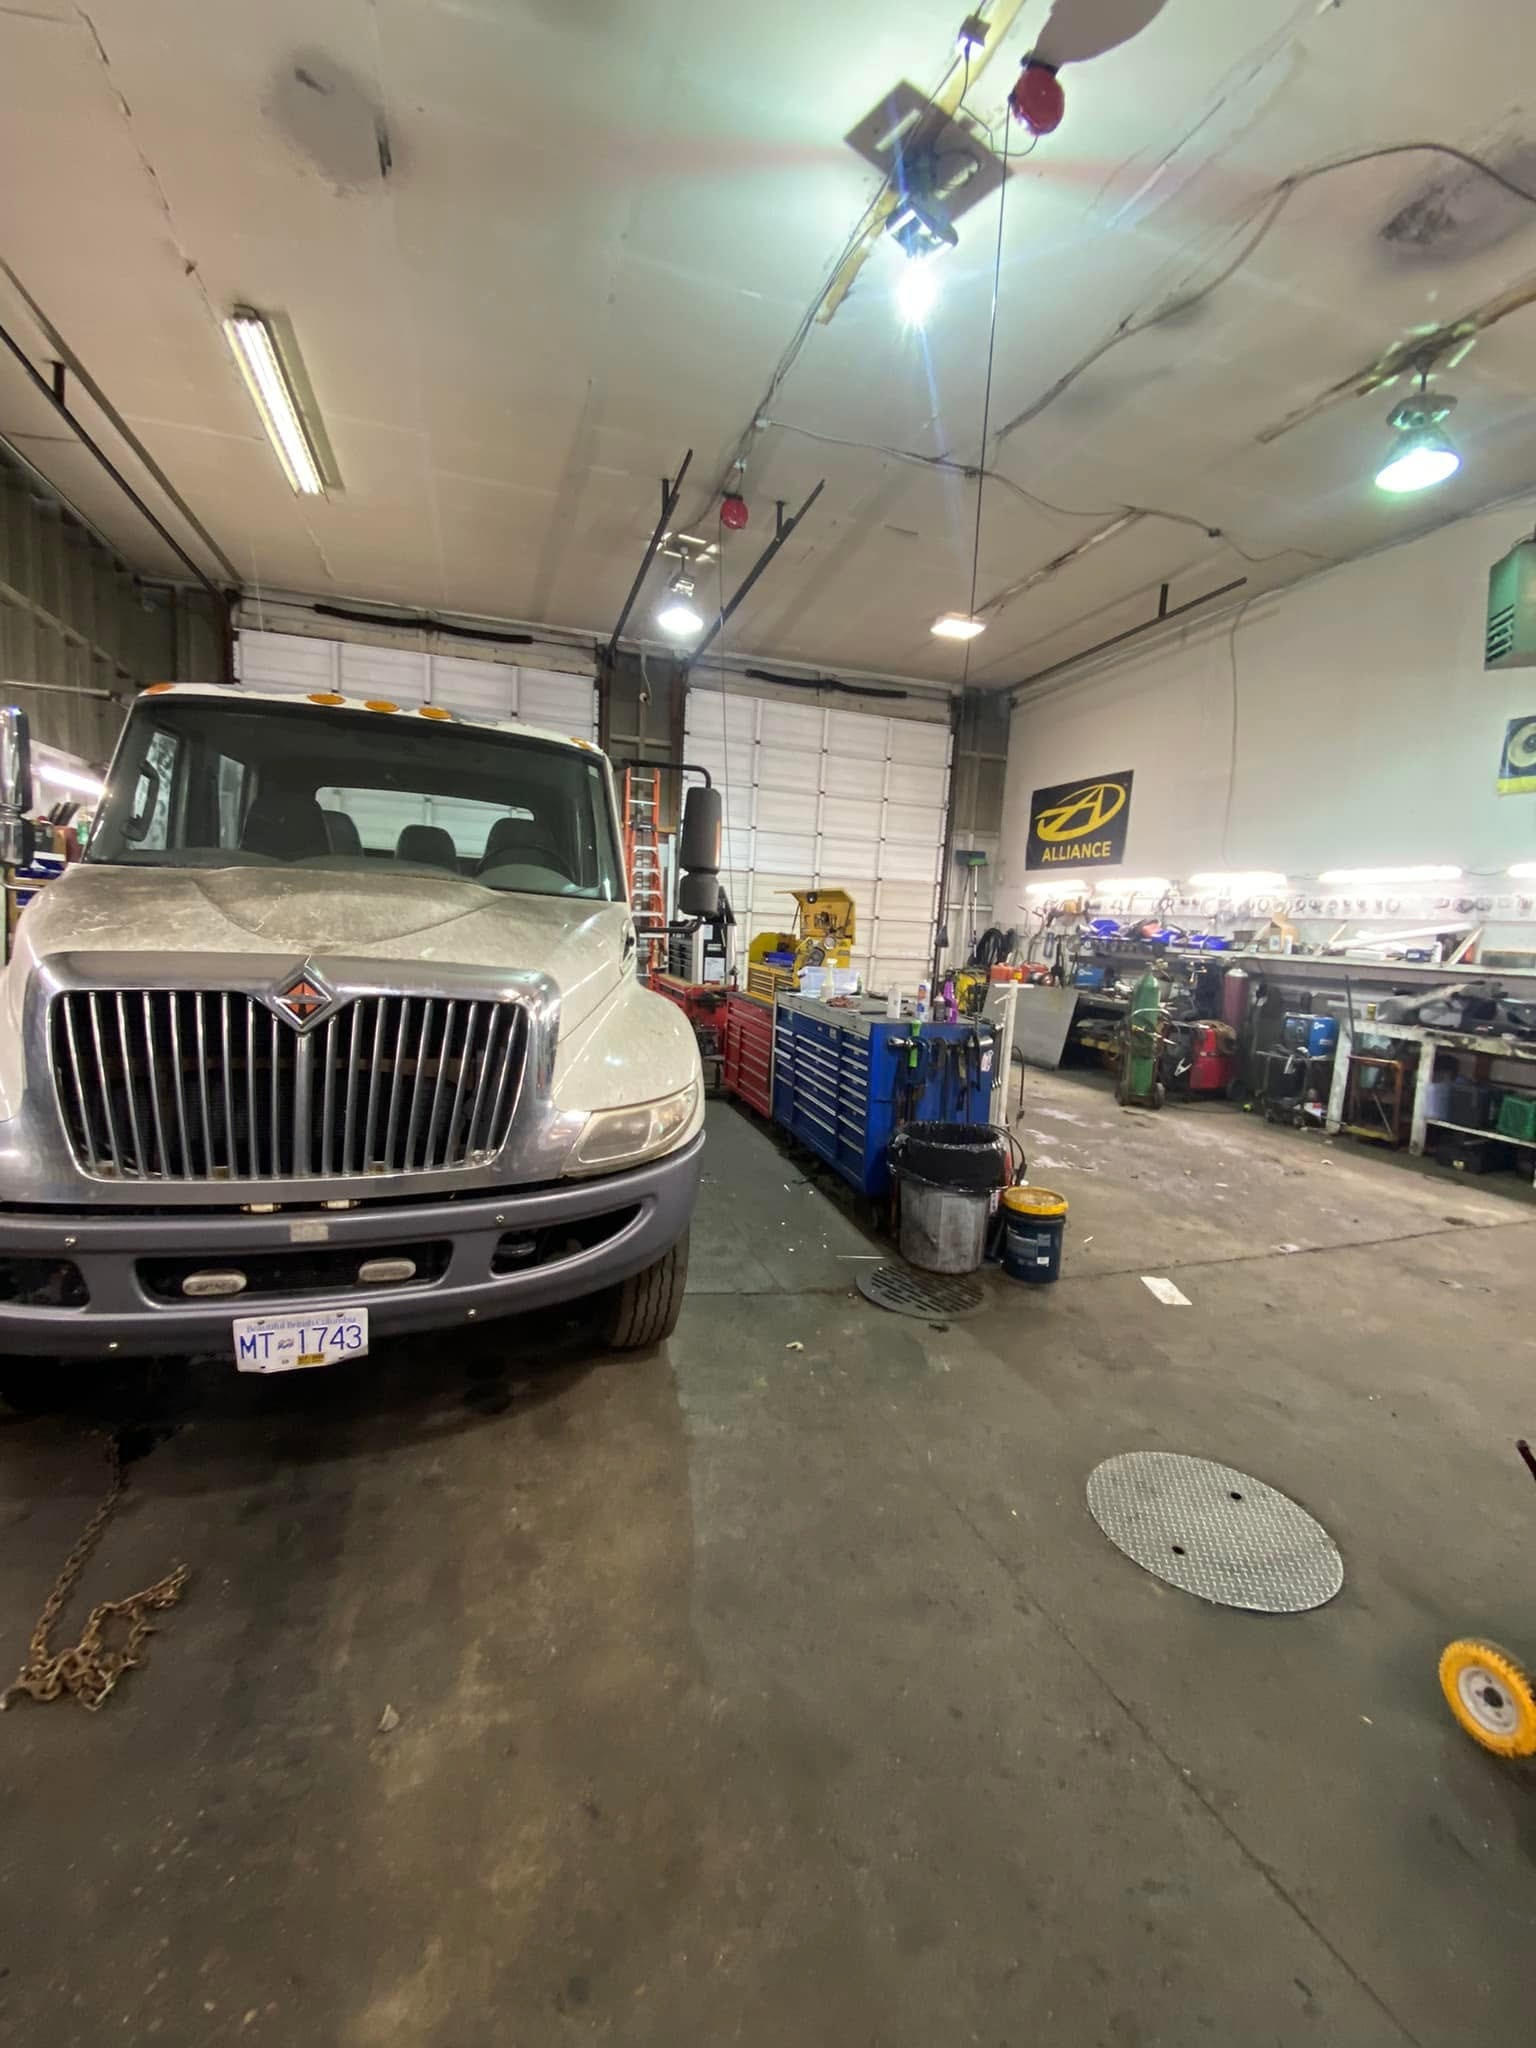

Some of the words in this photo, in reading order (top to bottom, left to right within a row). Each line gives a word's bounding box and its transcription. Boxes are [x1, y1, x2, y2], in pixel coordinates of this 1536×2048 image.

[1041, 841, 1112, 863] ALLIANCE
[239, 1332, 275, 1359] MT
[299, 1325, 361, 1354] 1743
